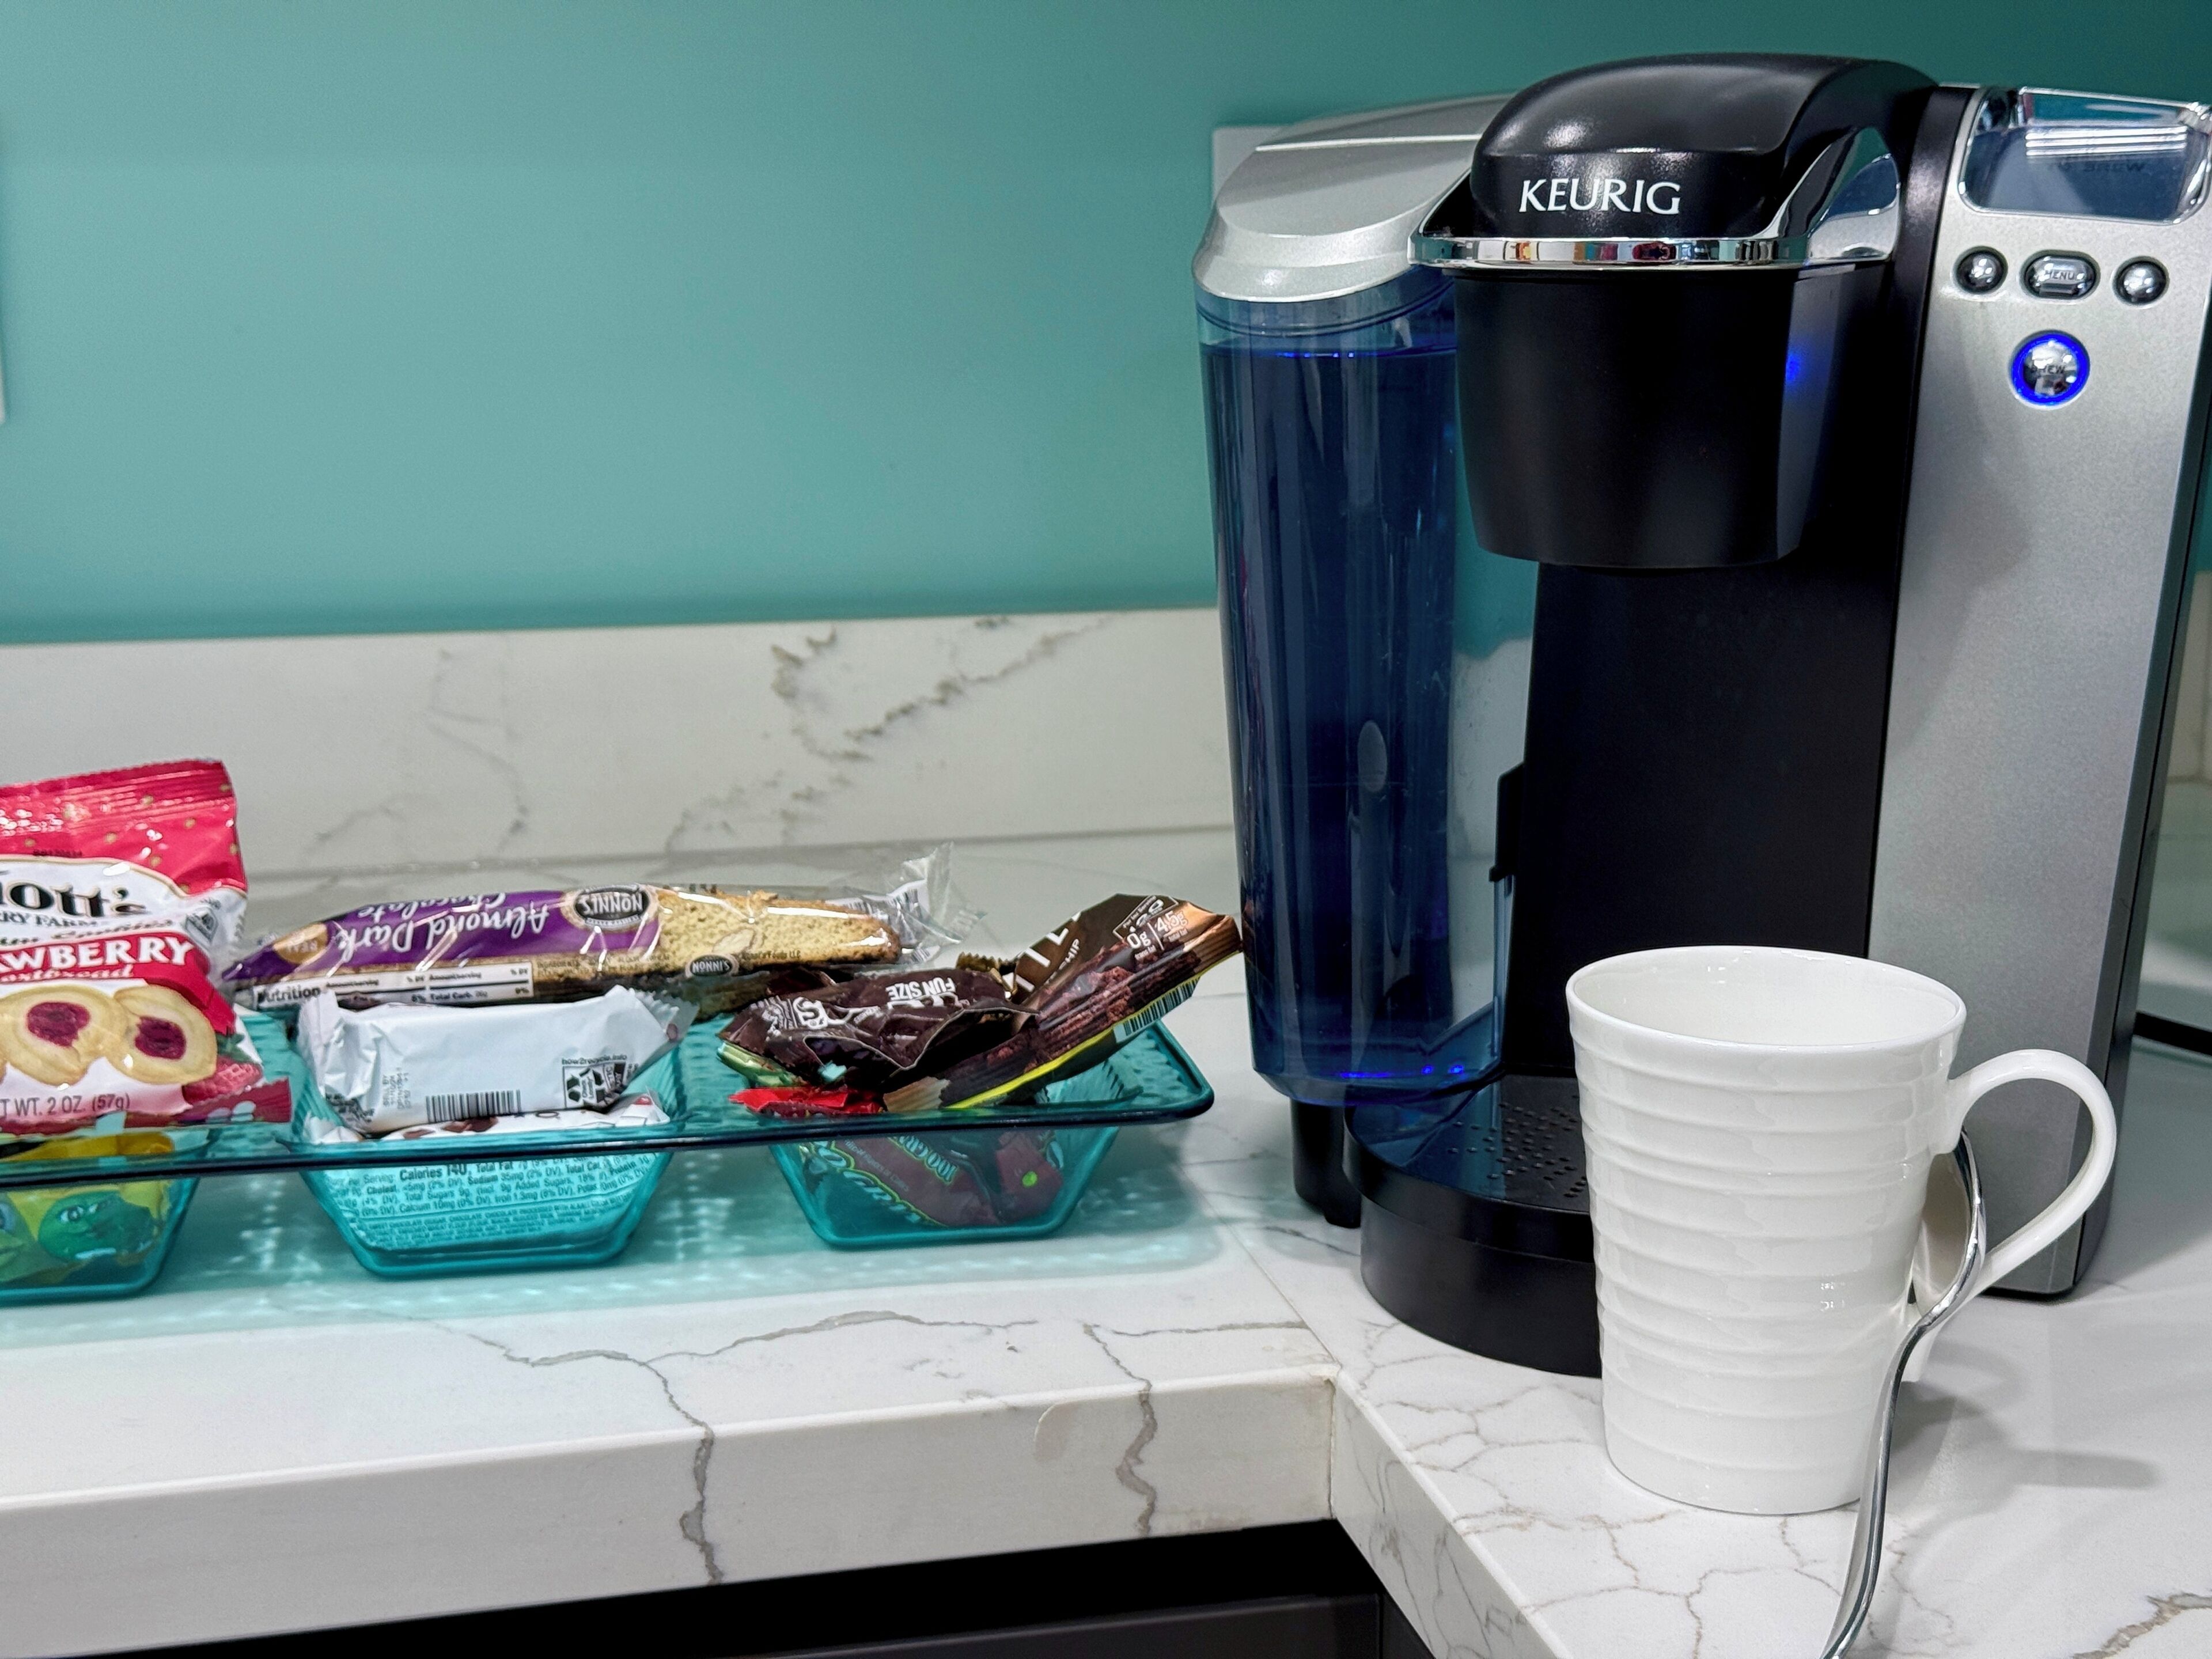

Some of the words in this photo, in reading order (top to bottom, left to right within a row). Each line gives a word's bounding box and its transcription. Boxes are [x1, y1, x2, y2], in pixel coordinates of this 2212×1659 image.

[1519, 178, 1681, 215] KEURIG
[578, 892, 643, 916] NONNI'S
[425, 903, 550, 949] Almond
[334, 918, 414, 963] Dark
[1127, 930, 1152, 949] 0g
[692, 960, 730, 972] NONNI'S
[257, 986, 321, 1003] Nutrition
[885, 982, 921, 1001] SIZE
[924, 976, 957, 995] FUN
[14, 1097, 43, 1116] WT.
[47, 1096, 56, 1114] 2
[92, 1092, 131, 1112] (57g)
[400, 1166, 443, 1181] Calories
